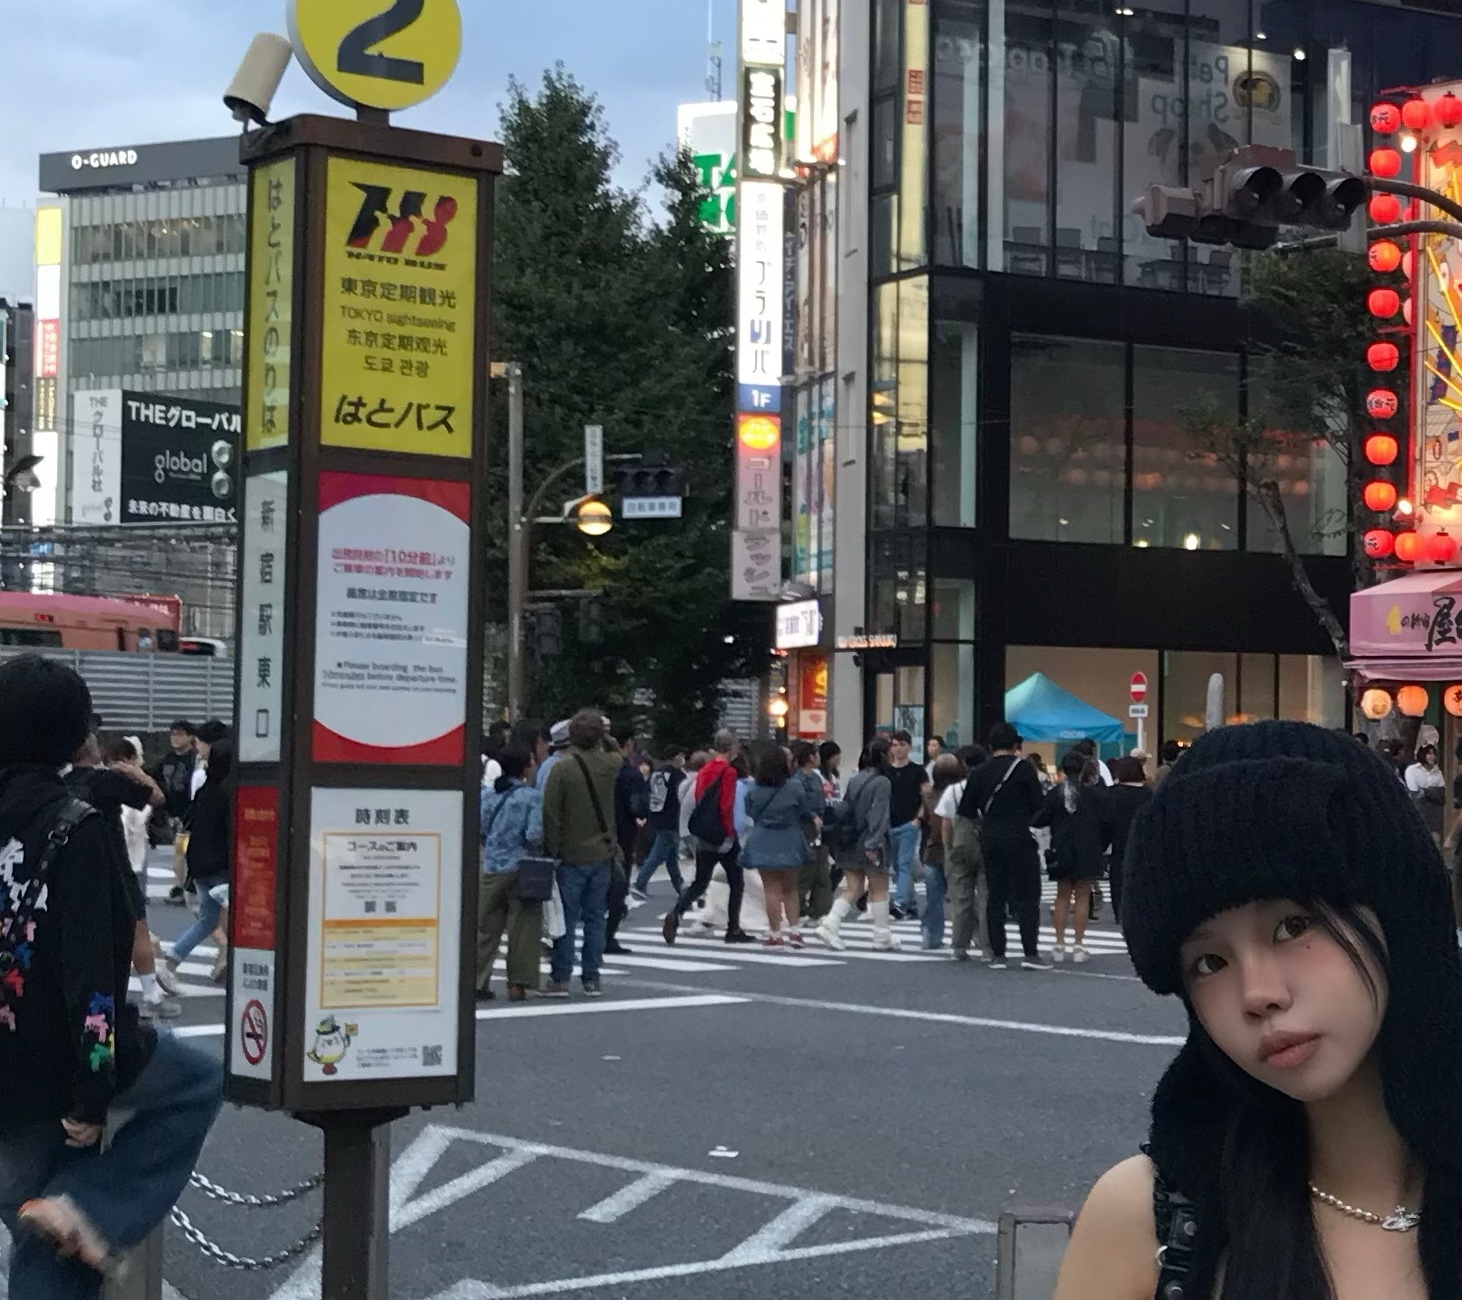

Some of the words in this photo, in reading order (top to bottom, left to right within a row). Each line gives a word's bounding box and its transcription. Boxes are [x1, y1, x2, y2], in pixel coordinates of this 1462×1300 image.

[71, 148, 138, 171] O-GUARD
[403, 256, 448, 271] BUS
[340, 276, 457, 309] 東京定期観光
[340, 305, 383, 324] TOKYO
[386, 313, 456, 333] sightseeing
[399, 359, 430, 379] 관광
[751, 389, 773, 410] 1F
[334, 393, 456, 435] はとバス
[154, 449, 208, 484] global
[355, 808, 410, 825] 時刻表
